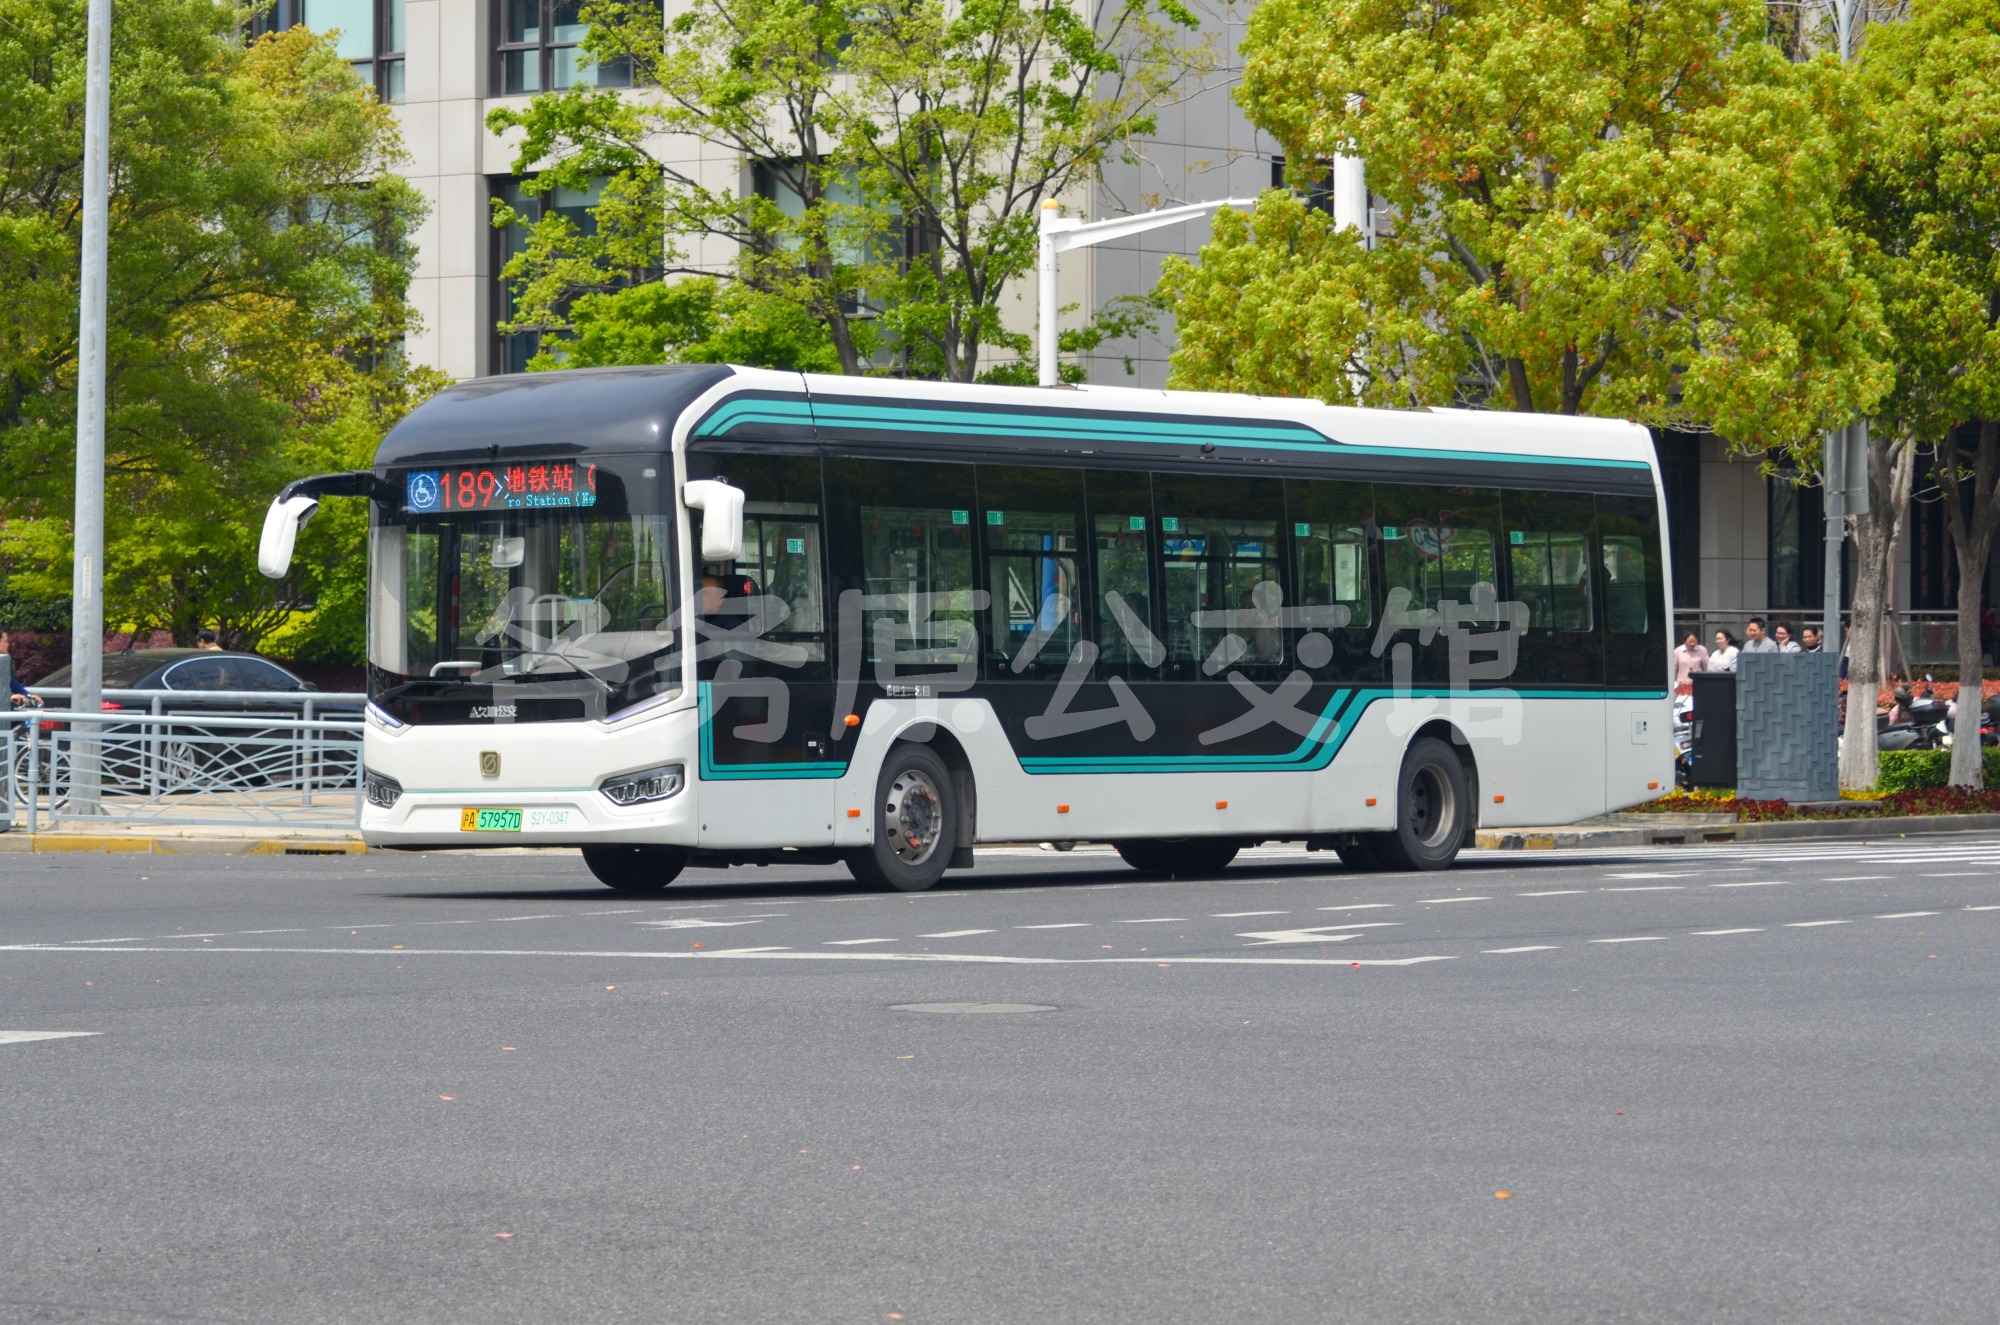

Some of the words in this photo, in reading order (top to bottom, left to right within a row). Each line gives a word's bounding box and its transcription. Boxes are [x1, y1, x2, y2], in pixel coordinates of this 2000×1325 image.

[440, 470, 495, 508] 189
[526, 492, 570, 507] Station
[531, 811, 569, 826] S2Y-0347
